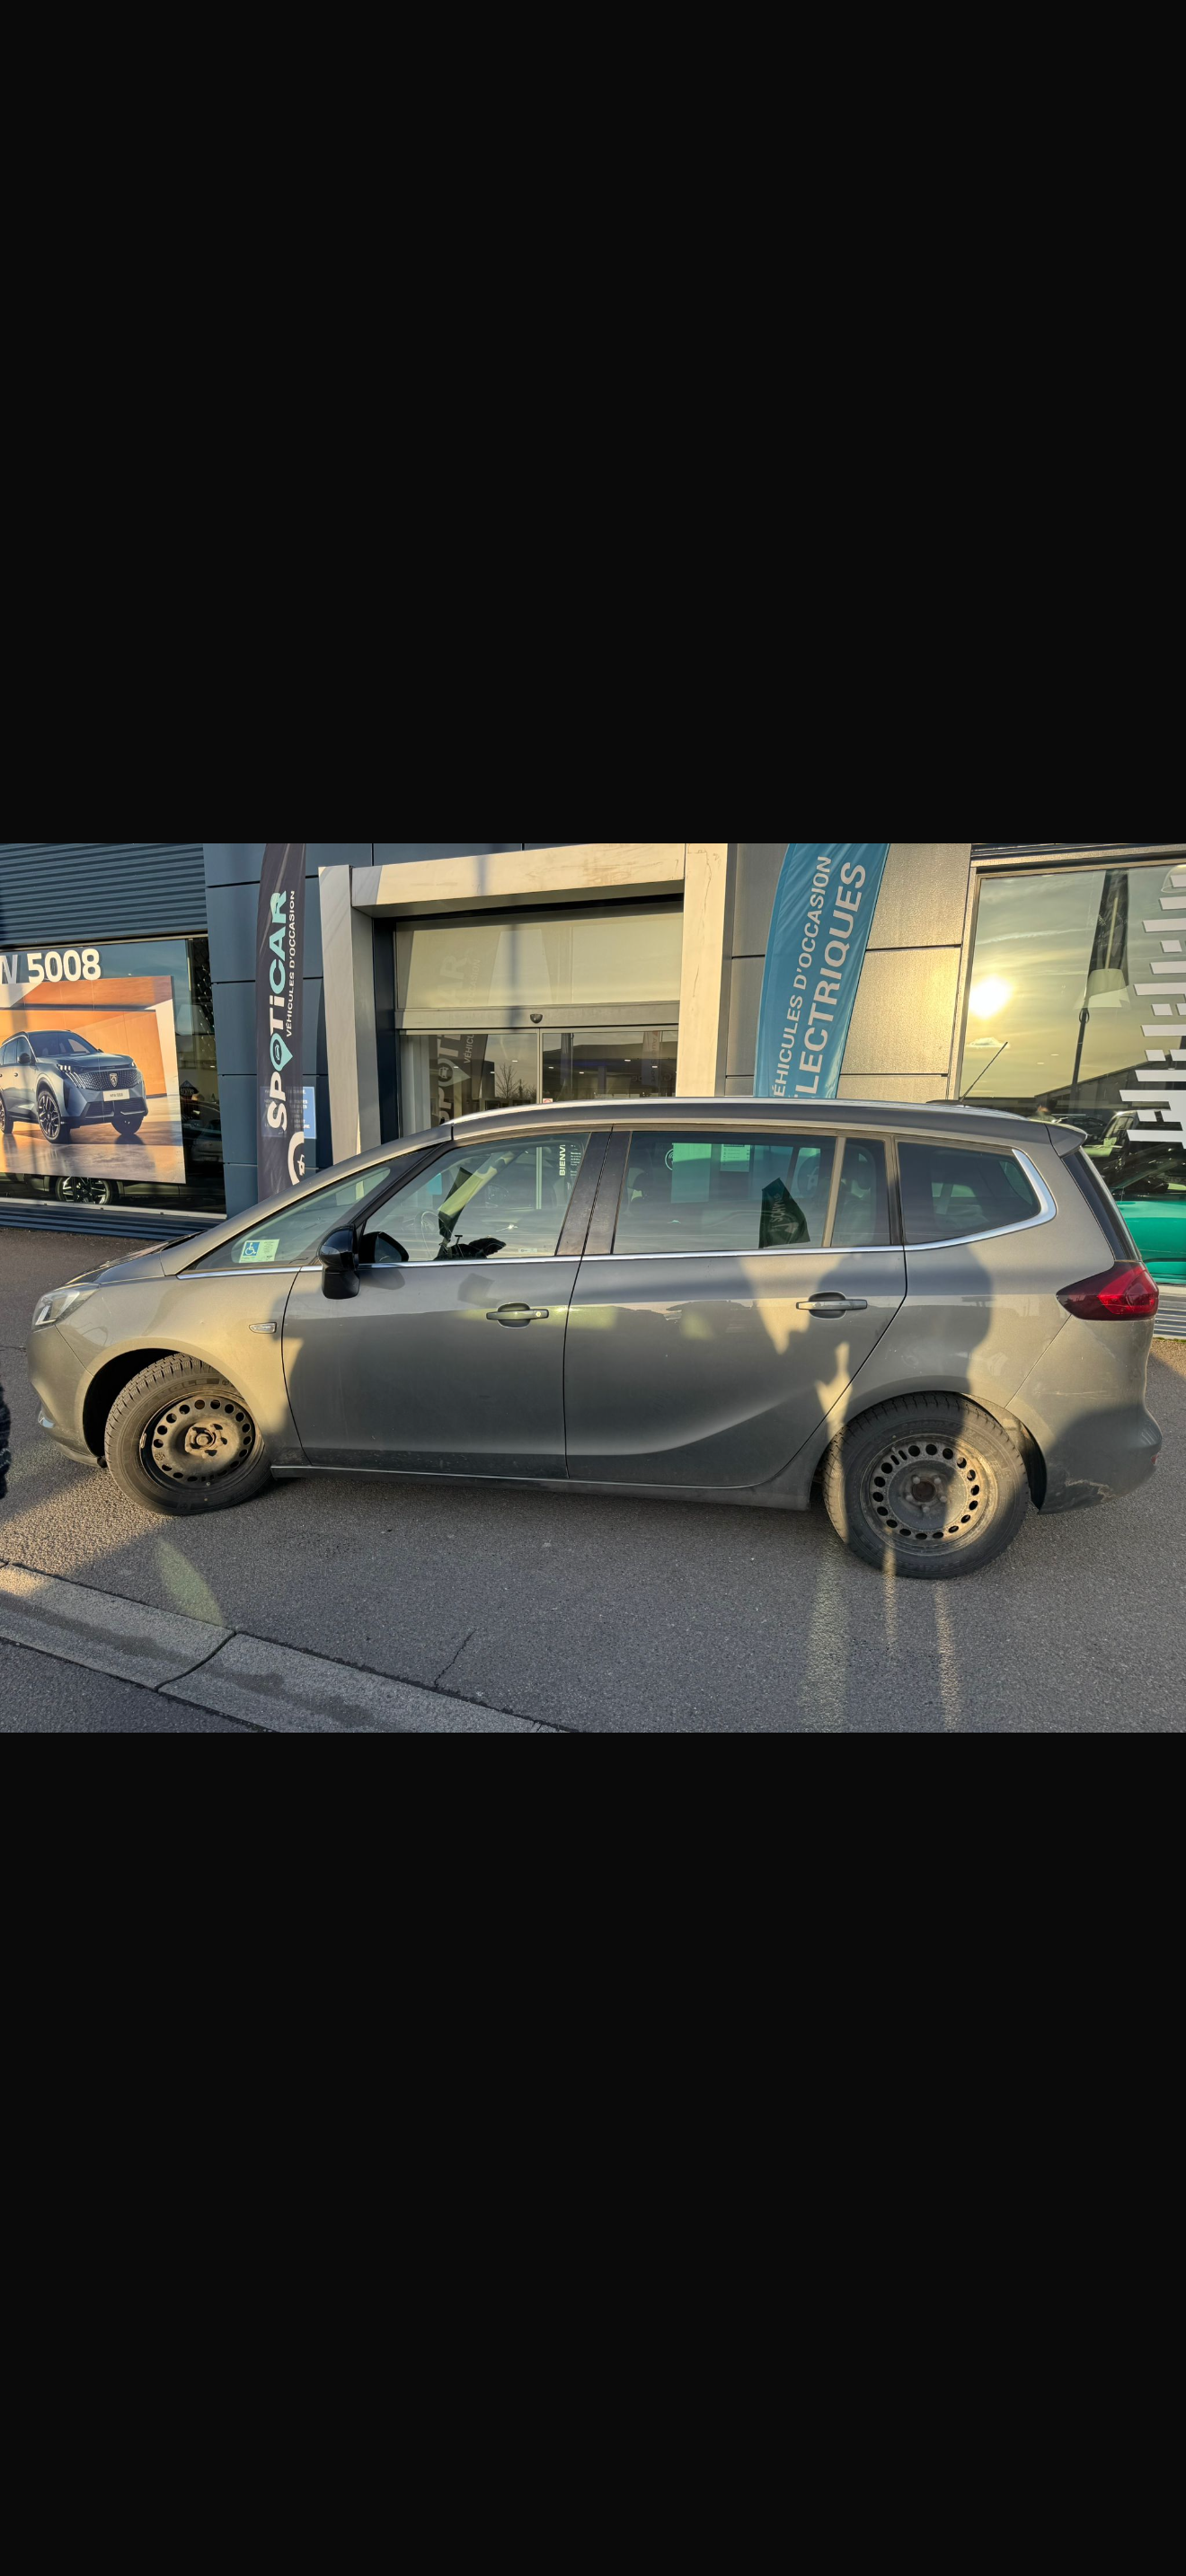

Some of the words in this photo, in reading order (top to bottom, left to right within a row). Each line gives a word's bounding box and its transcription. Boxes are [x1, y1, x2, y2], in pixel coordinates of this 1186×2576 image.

[27, 948, 102, 984] 5008
[288, 890, 296, 969] D'OCCASION
[286, 972, 295, 1037] VÉHICULES
[772, 994, 803, 1097] ÉHICULES
[792, 856, 832, 990] D'OCCASION
[794, 861, 866, 1098] LECTRIQUES
